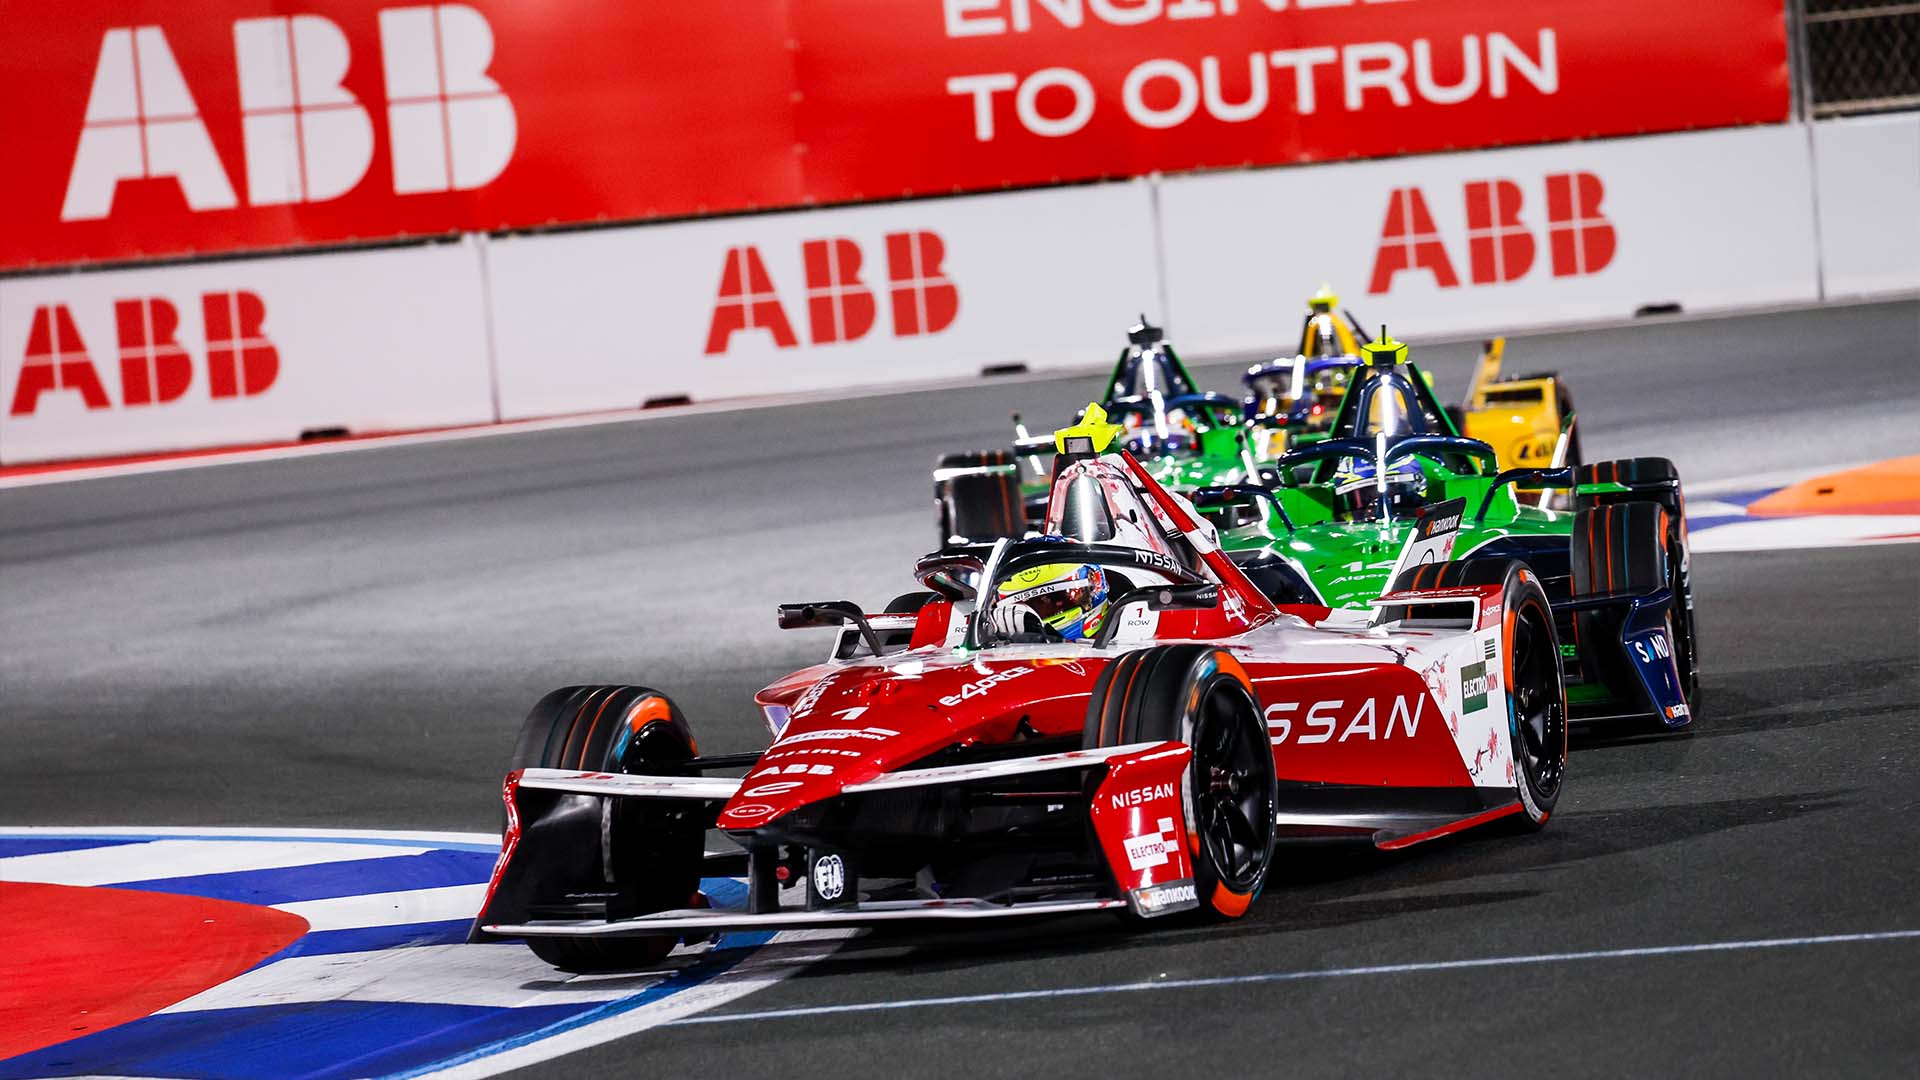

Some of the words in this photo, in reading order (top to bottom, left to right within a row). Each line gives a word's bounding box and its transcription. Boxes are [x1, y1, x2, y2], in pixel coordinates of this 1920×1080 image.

[947, 67, 1095, 141] TO
[1122, 28, 1558, 129] OUTRUN
[61, 4, 517, 221] ABB
[1368, 171, 1617, 295] ABB
[704, 230, 959, 355] ABB
[10, 290, 280, 416] ABB
[1135, 550, 1181, 575] NISSAN
[1014, 586, 1055, 601] NISSAN
[1136, 608, 1143, 618] 1
[831, 706, 869, 720] 1
[750, 764, 834, 779] ABB
[1112, 782, 1173, 809] NISSAN
[817, 864, 842, 892] FIA
